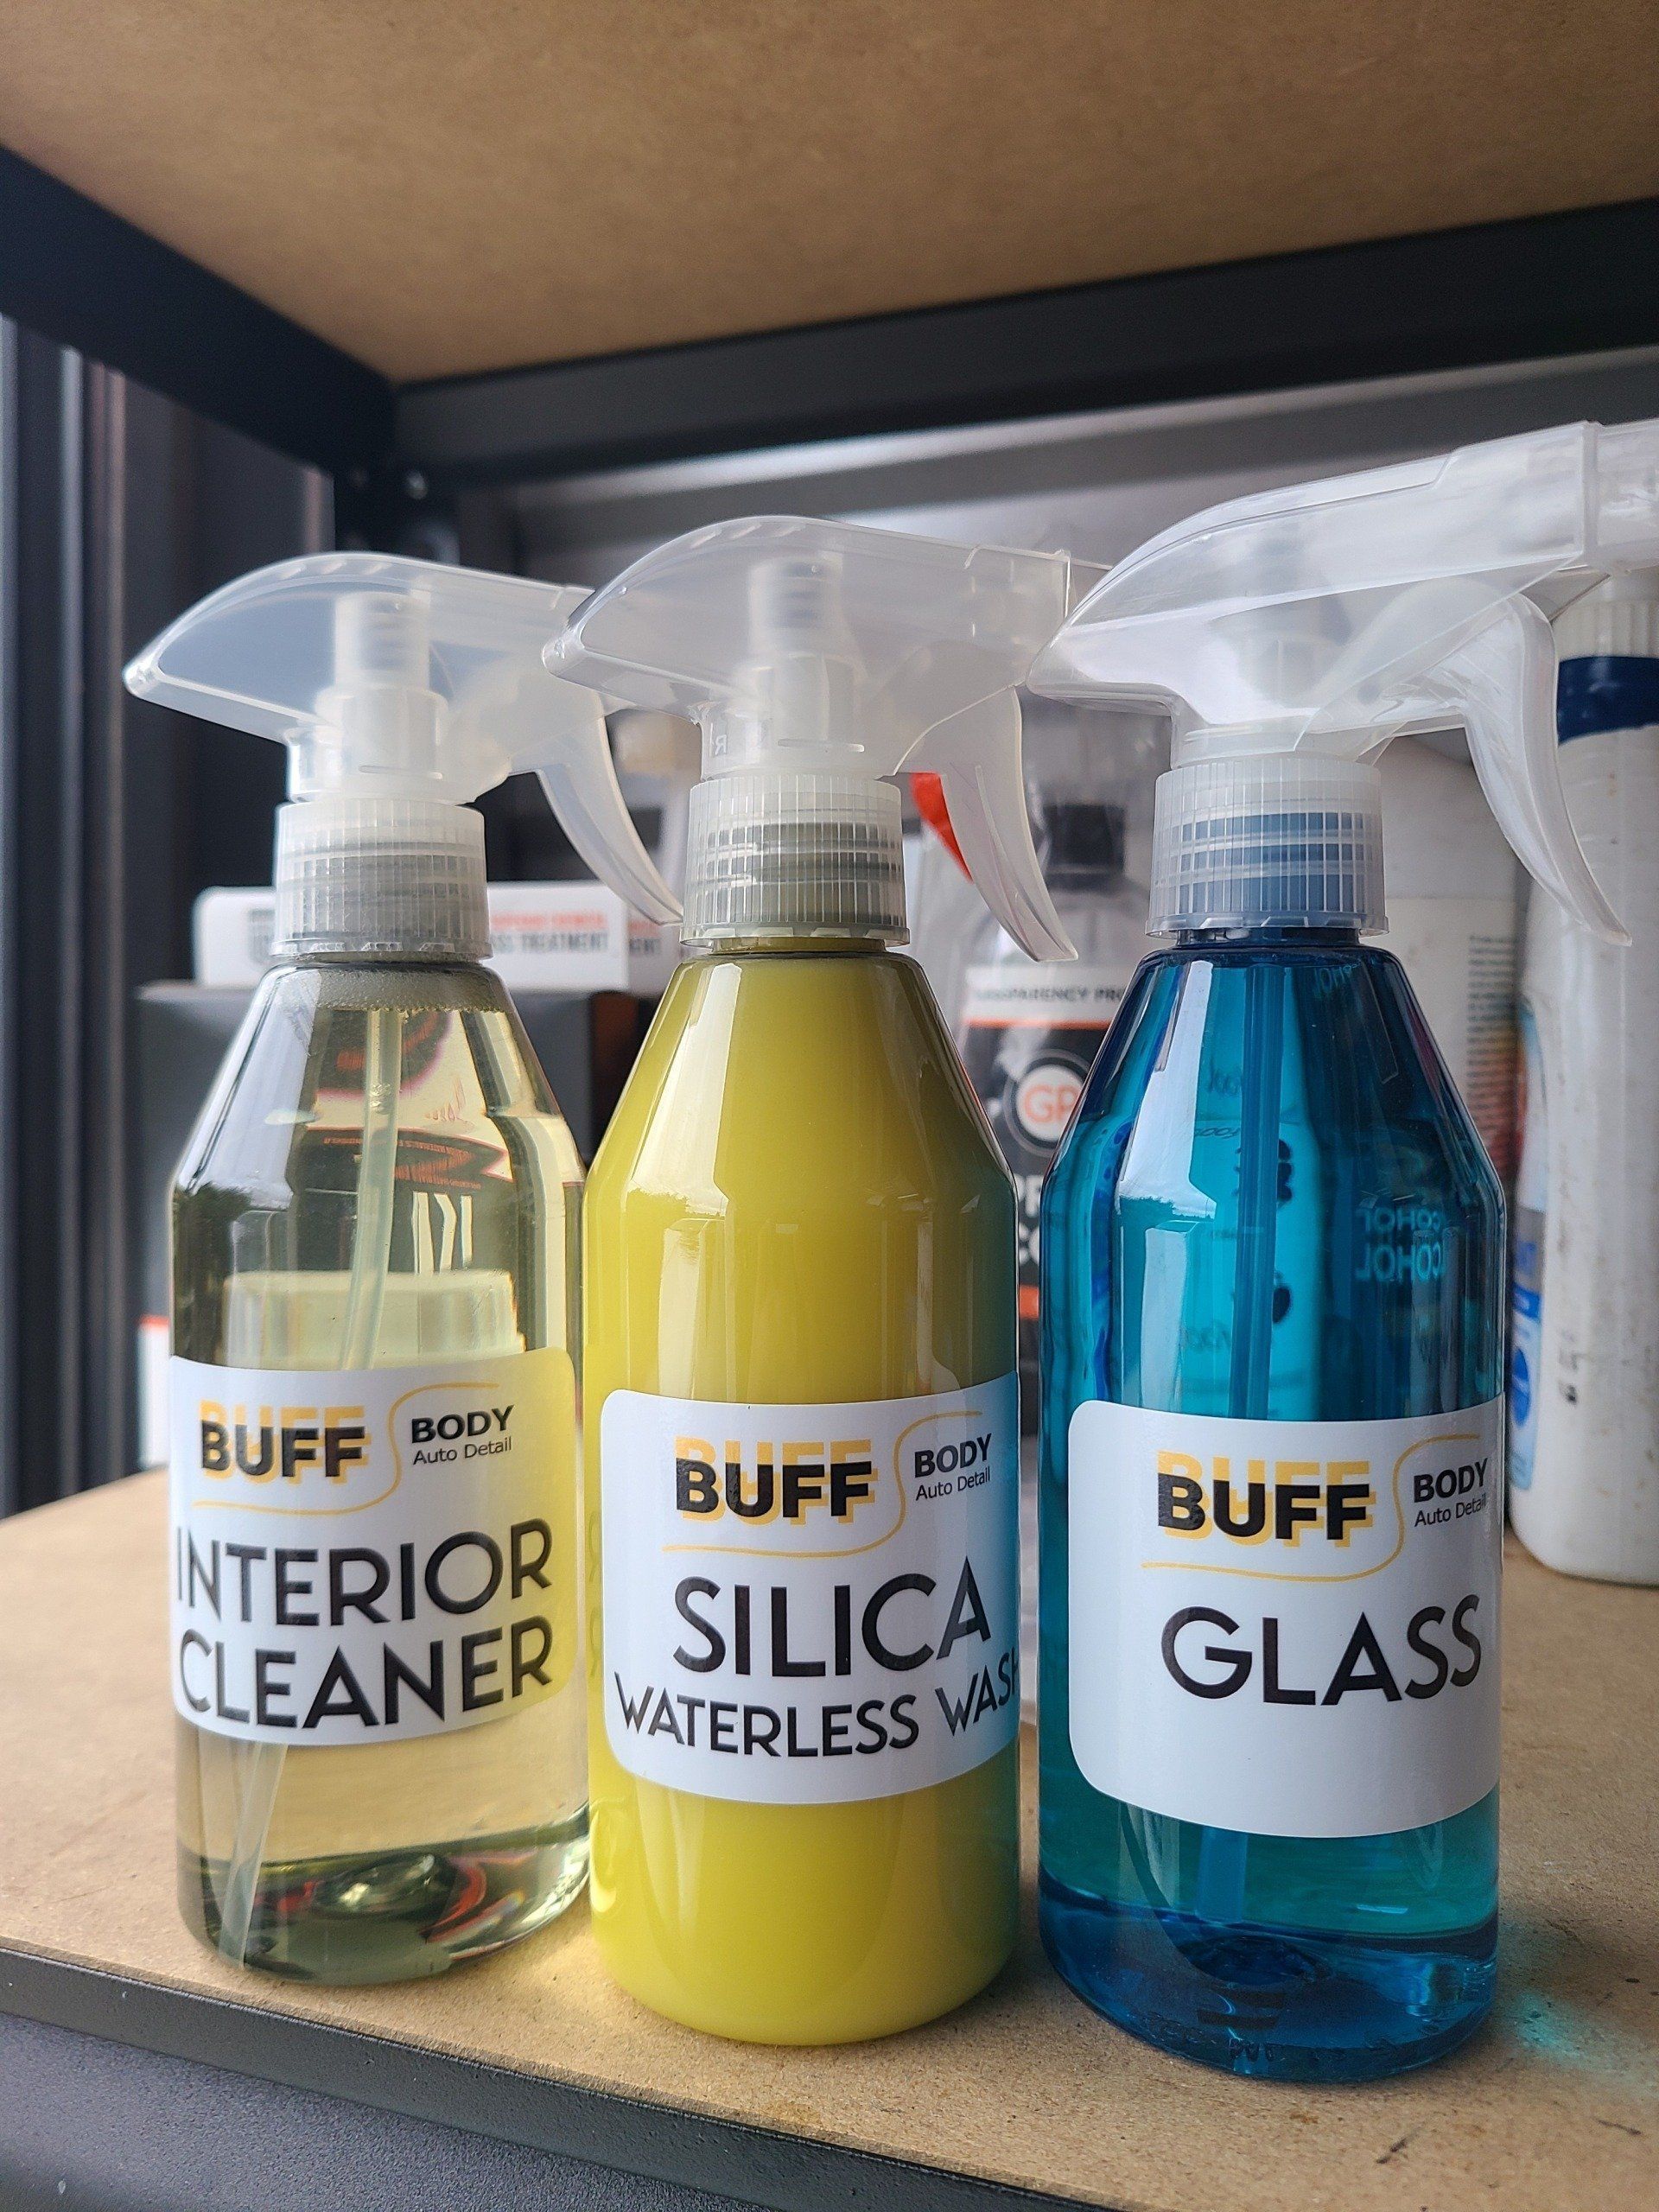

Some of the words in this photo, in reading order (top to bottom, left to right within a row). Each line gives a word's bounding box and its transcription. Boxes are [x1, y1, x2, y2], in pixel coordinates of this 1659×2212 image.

[199, 1400, 372, 1486] BUFF
[410, 1405, 516, 1444] BODY
[412, 1448, 459, 1466] Auto
[464, 1437, 513, 1460] Detail
[913, 1433, 993, 1478] BODY
[674, 1435, 881, 1526] BUFF
[915, 1482, 953, 1502] Auto
[957, 1467, 992, 1493] Detail
[1157, 1450, 1377, 1548] BUFF
[1414, 1457, 1489, 1503] BODY
[1414, 1508, 1452, 1528] Auto
[177, 1517, 554, 1627] INTERIOR
[672, 1555, 993, 1678] SILICA
[1160, 1593, 1483, 1707] GLASS
[179, 1615, 554, 1730] CLEANER
[613, 1671, 920, 1758] WATERLESS
